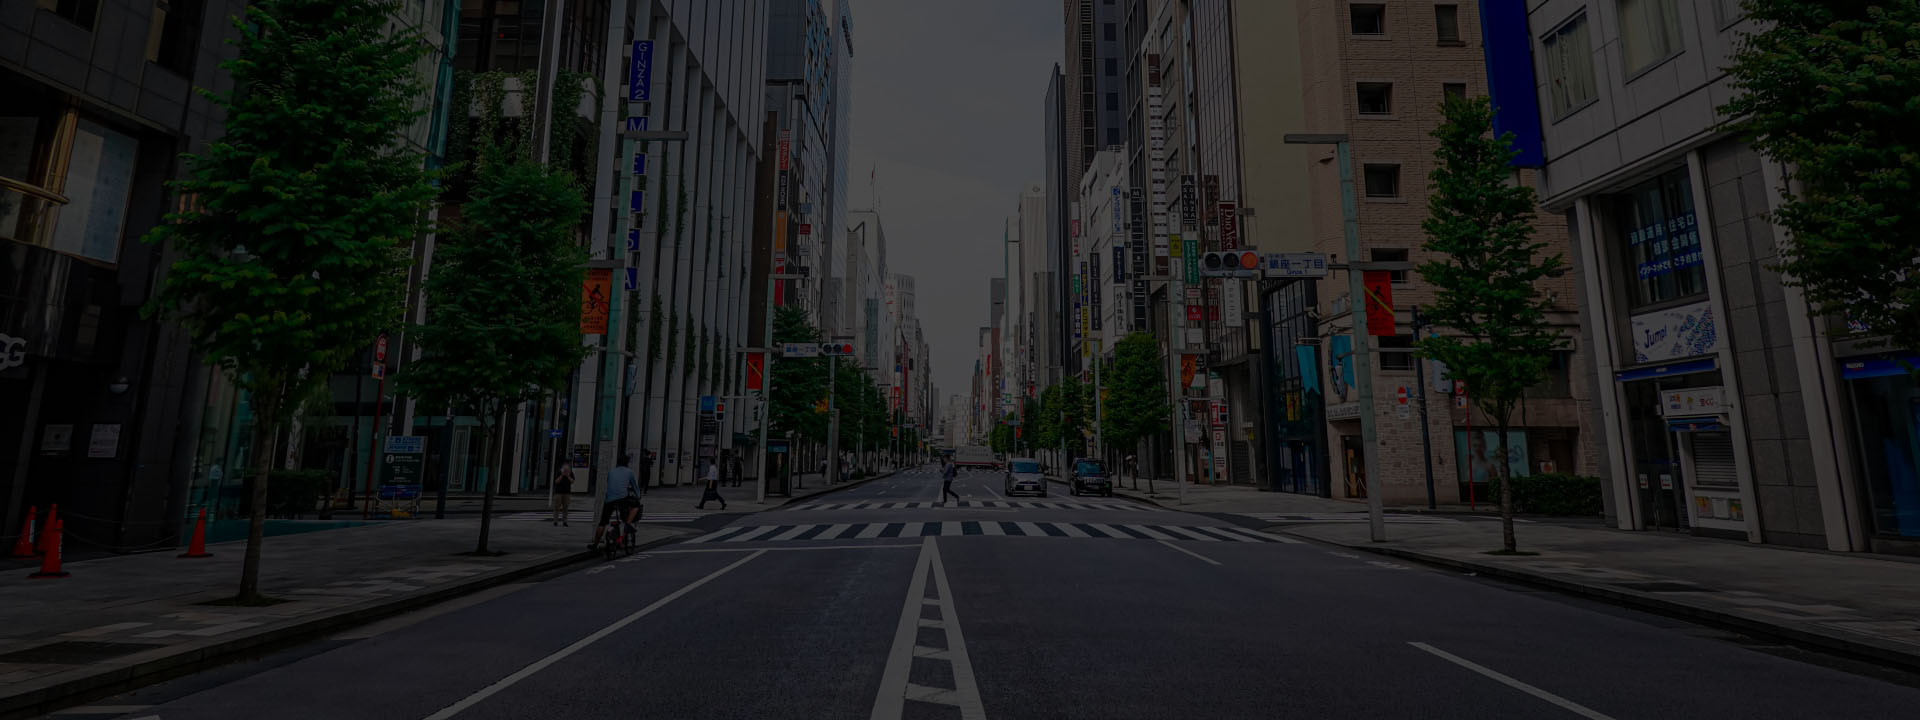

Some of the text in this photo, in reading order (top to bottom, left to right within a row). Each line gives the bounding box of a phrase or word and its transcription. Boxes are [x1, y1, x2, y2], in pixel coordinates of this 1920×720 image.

[1269, 259, 1324, 269] 銀座一丁目
